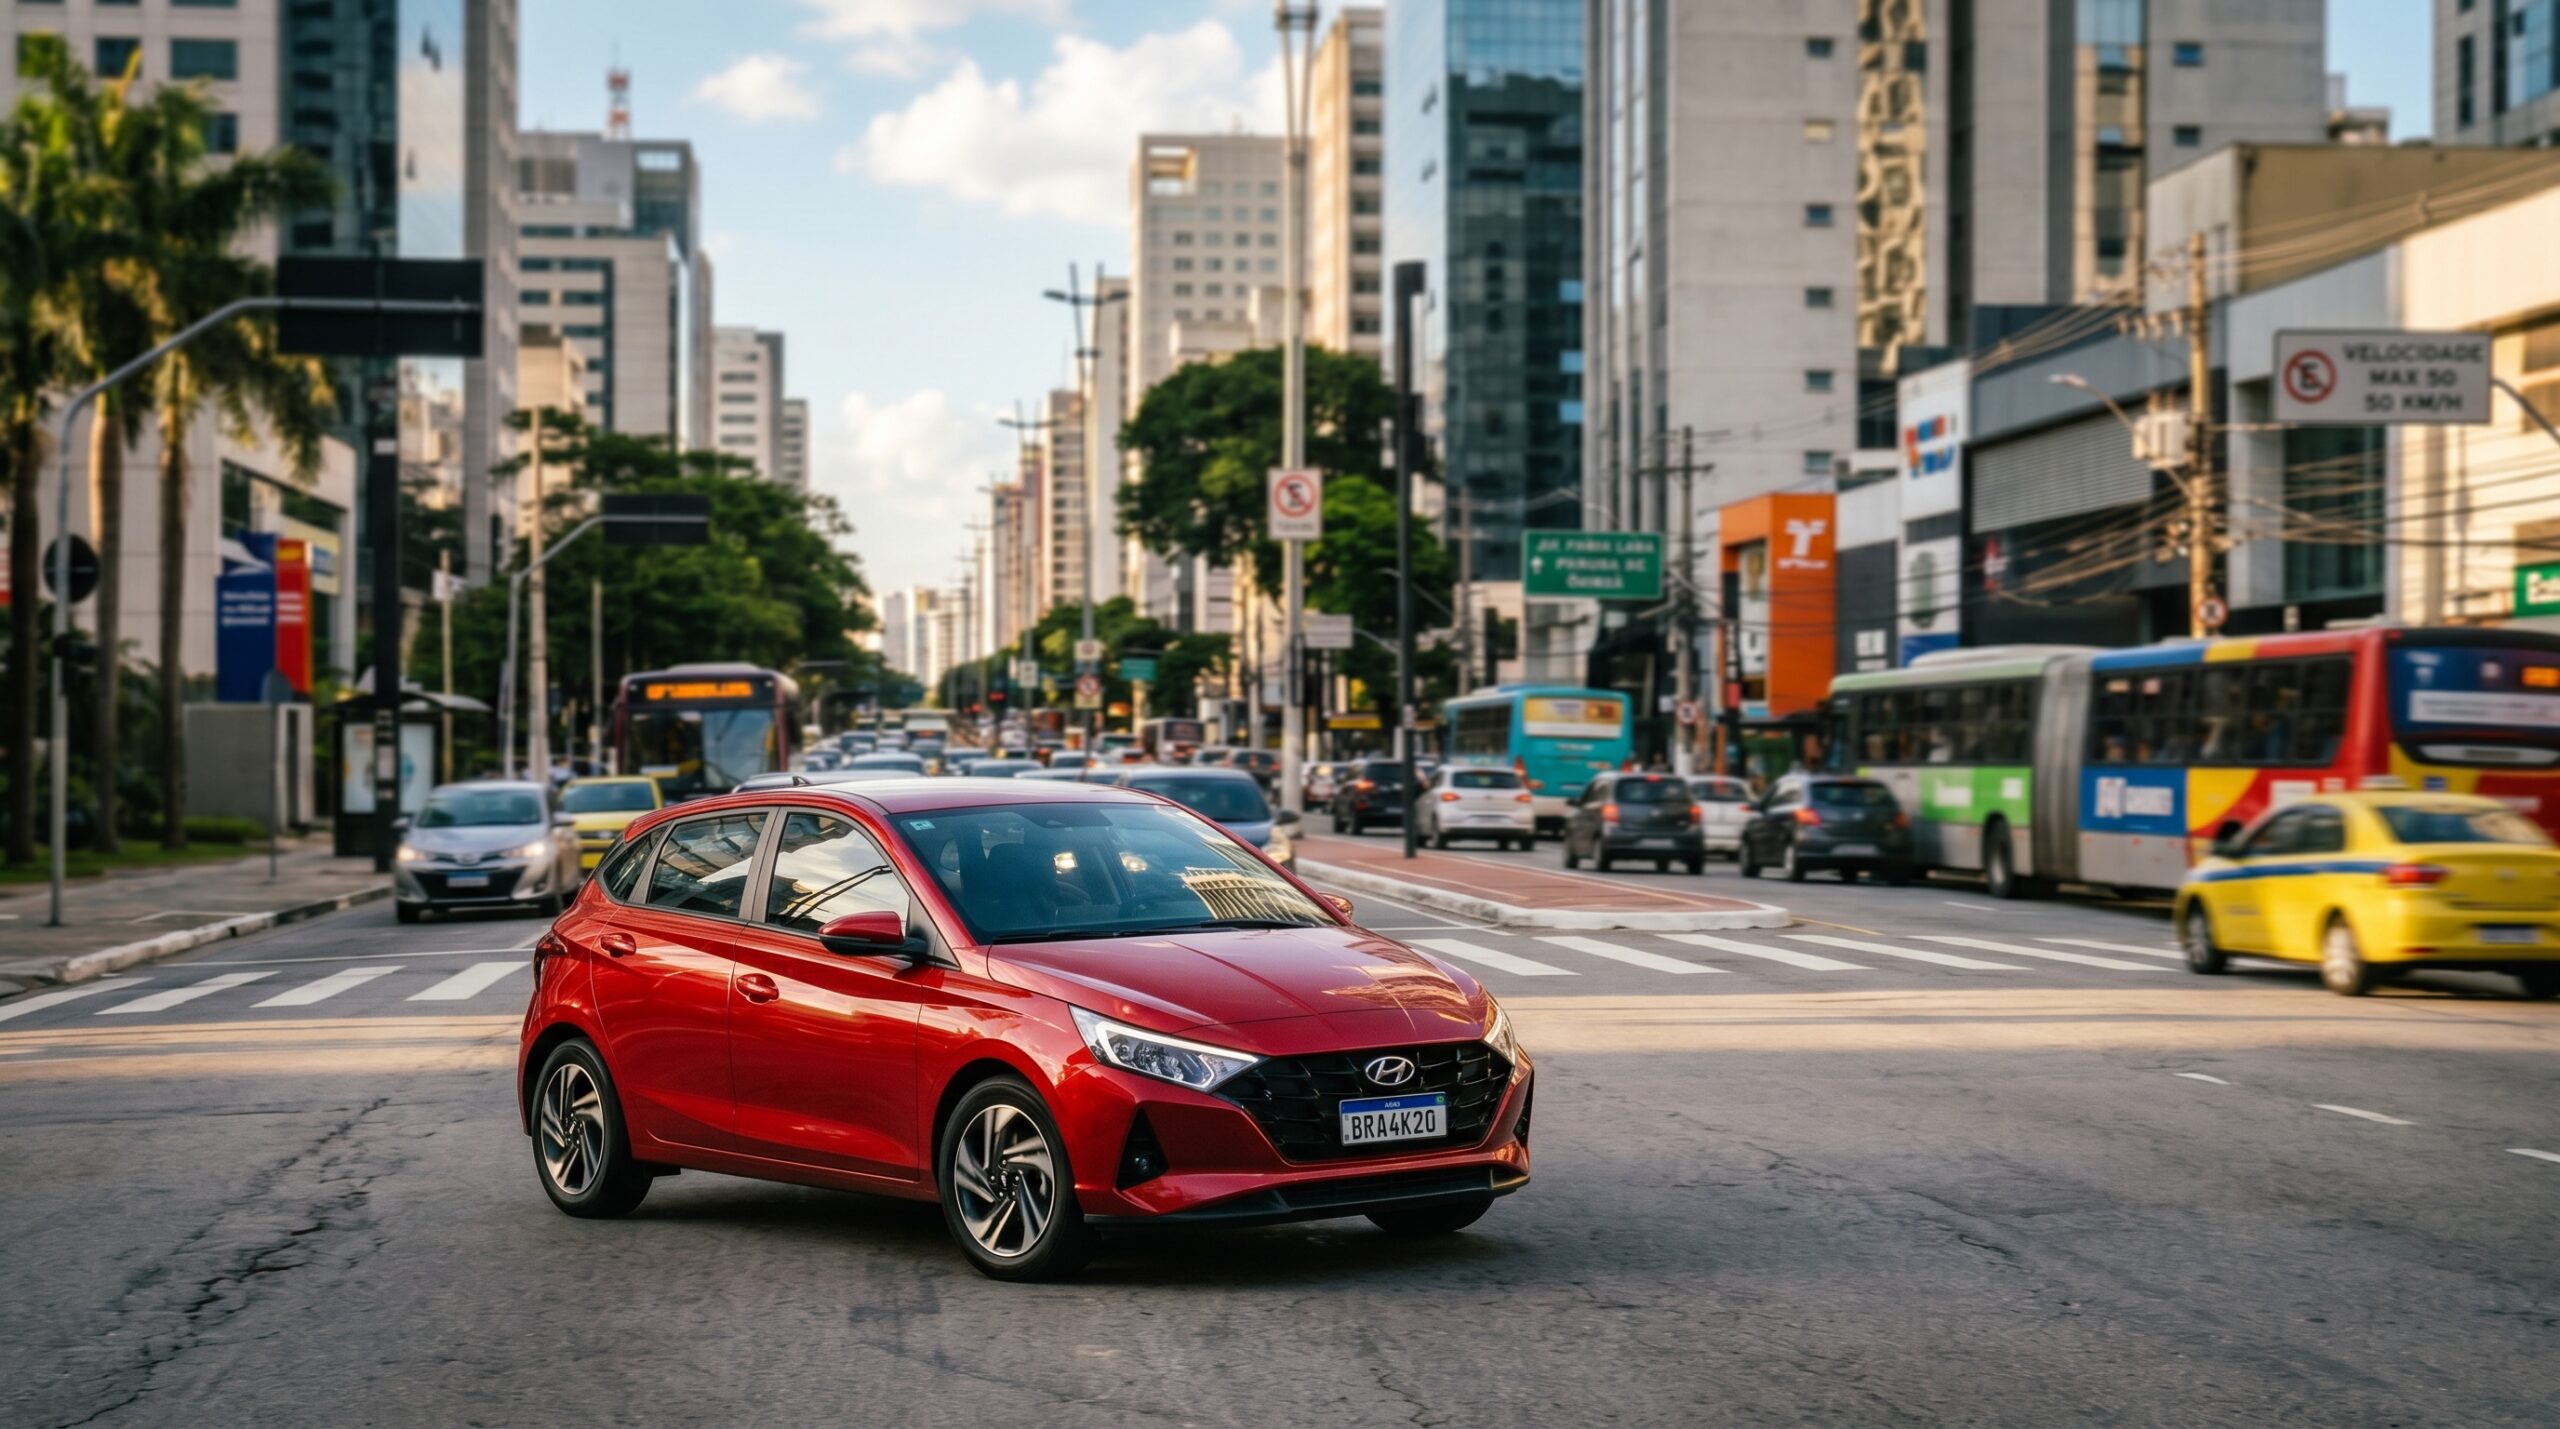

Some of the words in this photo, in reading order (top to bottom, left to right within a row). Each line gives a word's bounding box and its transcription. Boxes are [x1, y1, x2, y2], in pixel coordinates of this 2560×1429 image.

[2343, 344, 2484, 363] VELOCIDADE
[2369, 369, 2419, 386] MAX
[2427, 369, 2458, 388] 50
[2364, 394, 2395, 413] 50
[2401, 395, 2463, 412] KM/H
[1352, 1109, 1437, 1140] BRA4K20
